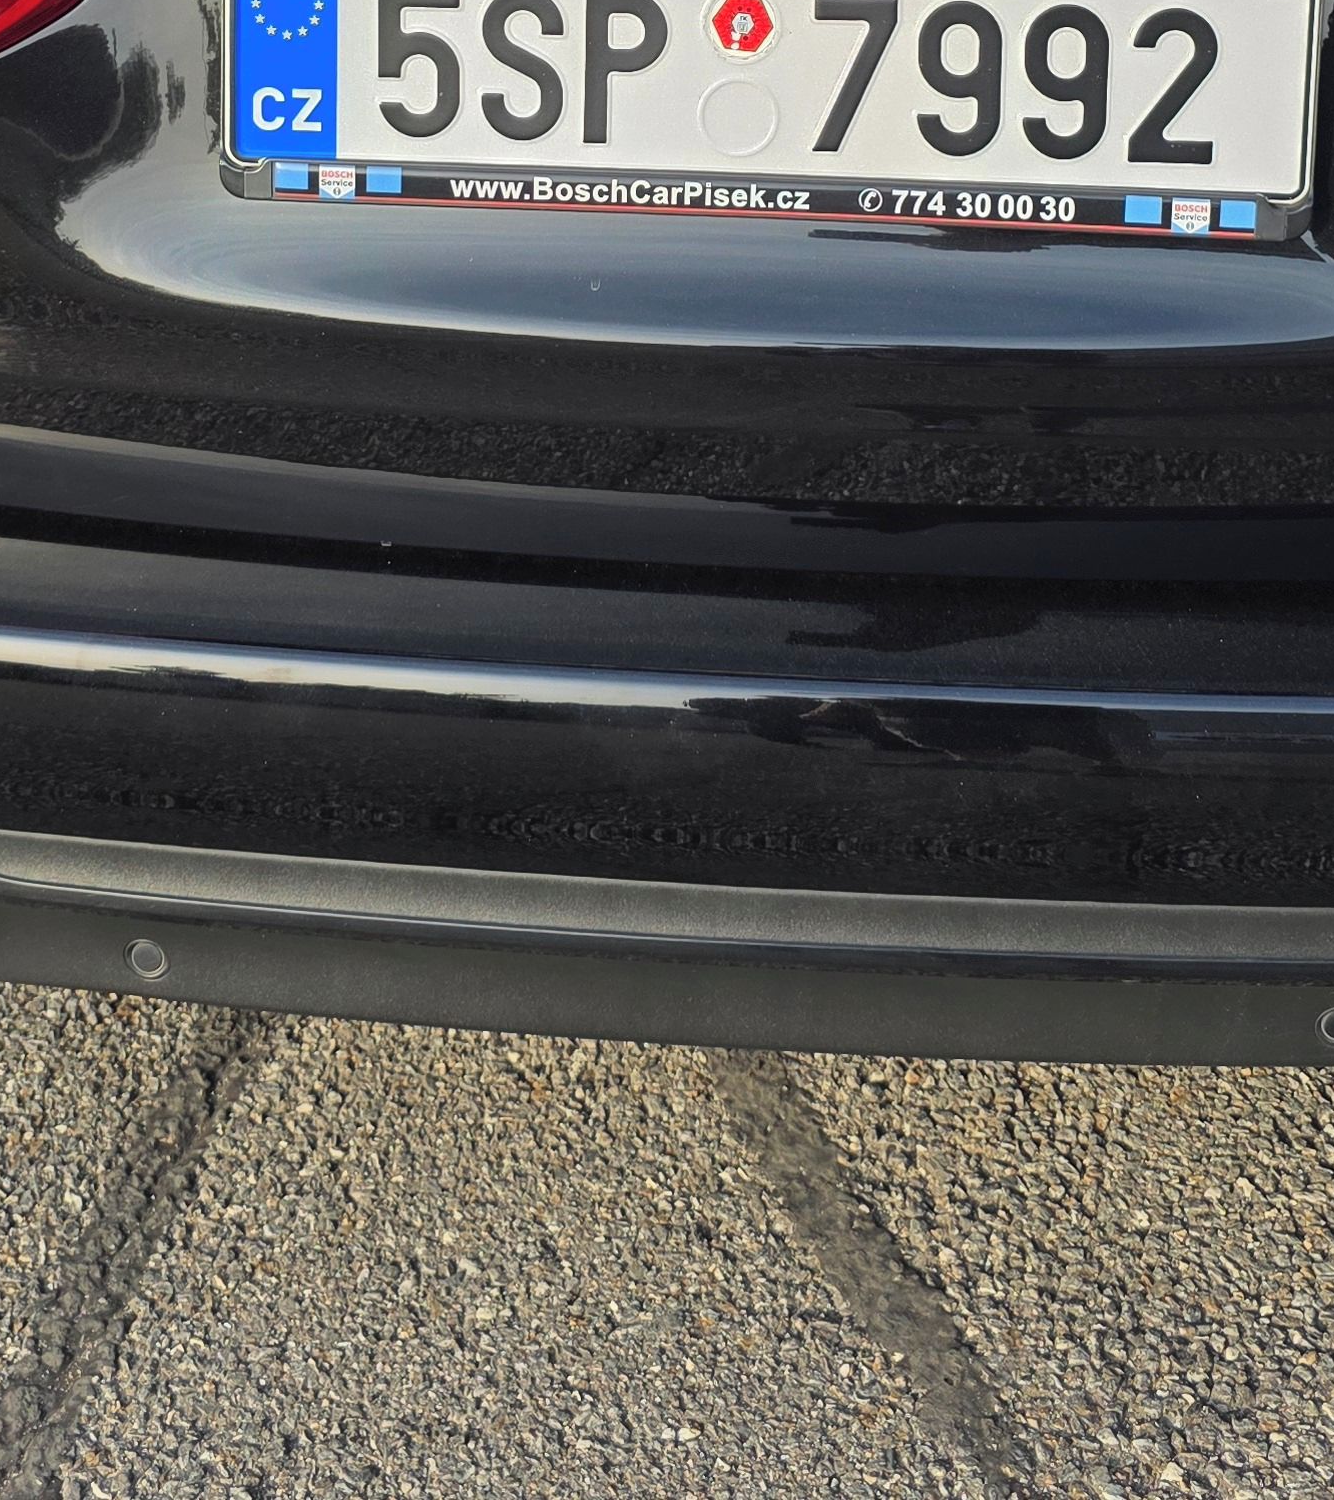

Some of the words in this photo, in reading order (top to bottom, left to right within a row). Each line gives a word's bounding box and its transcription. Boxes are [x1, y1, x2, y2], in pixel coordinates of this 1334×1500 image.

[252, 86, 323, 132] CZ
[321, 170, 353, 178] BOSCH
[321, 179, 353, 187] Service
[449, 176, 811, 210] www.BoschCarPisek.cz
[891, 189, 946, 216] 774
[1174, 203, 1208, 213] BOSCH
[1173, 213, 1208, 222] Service
